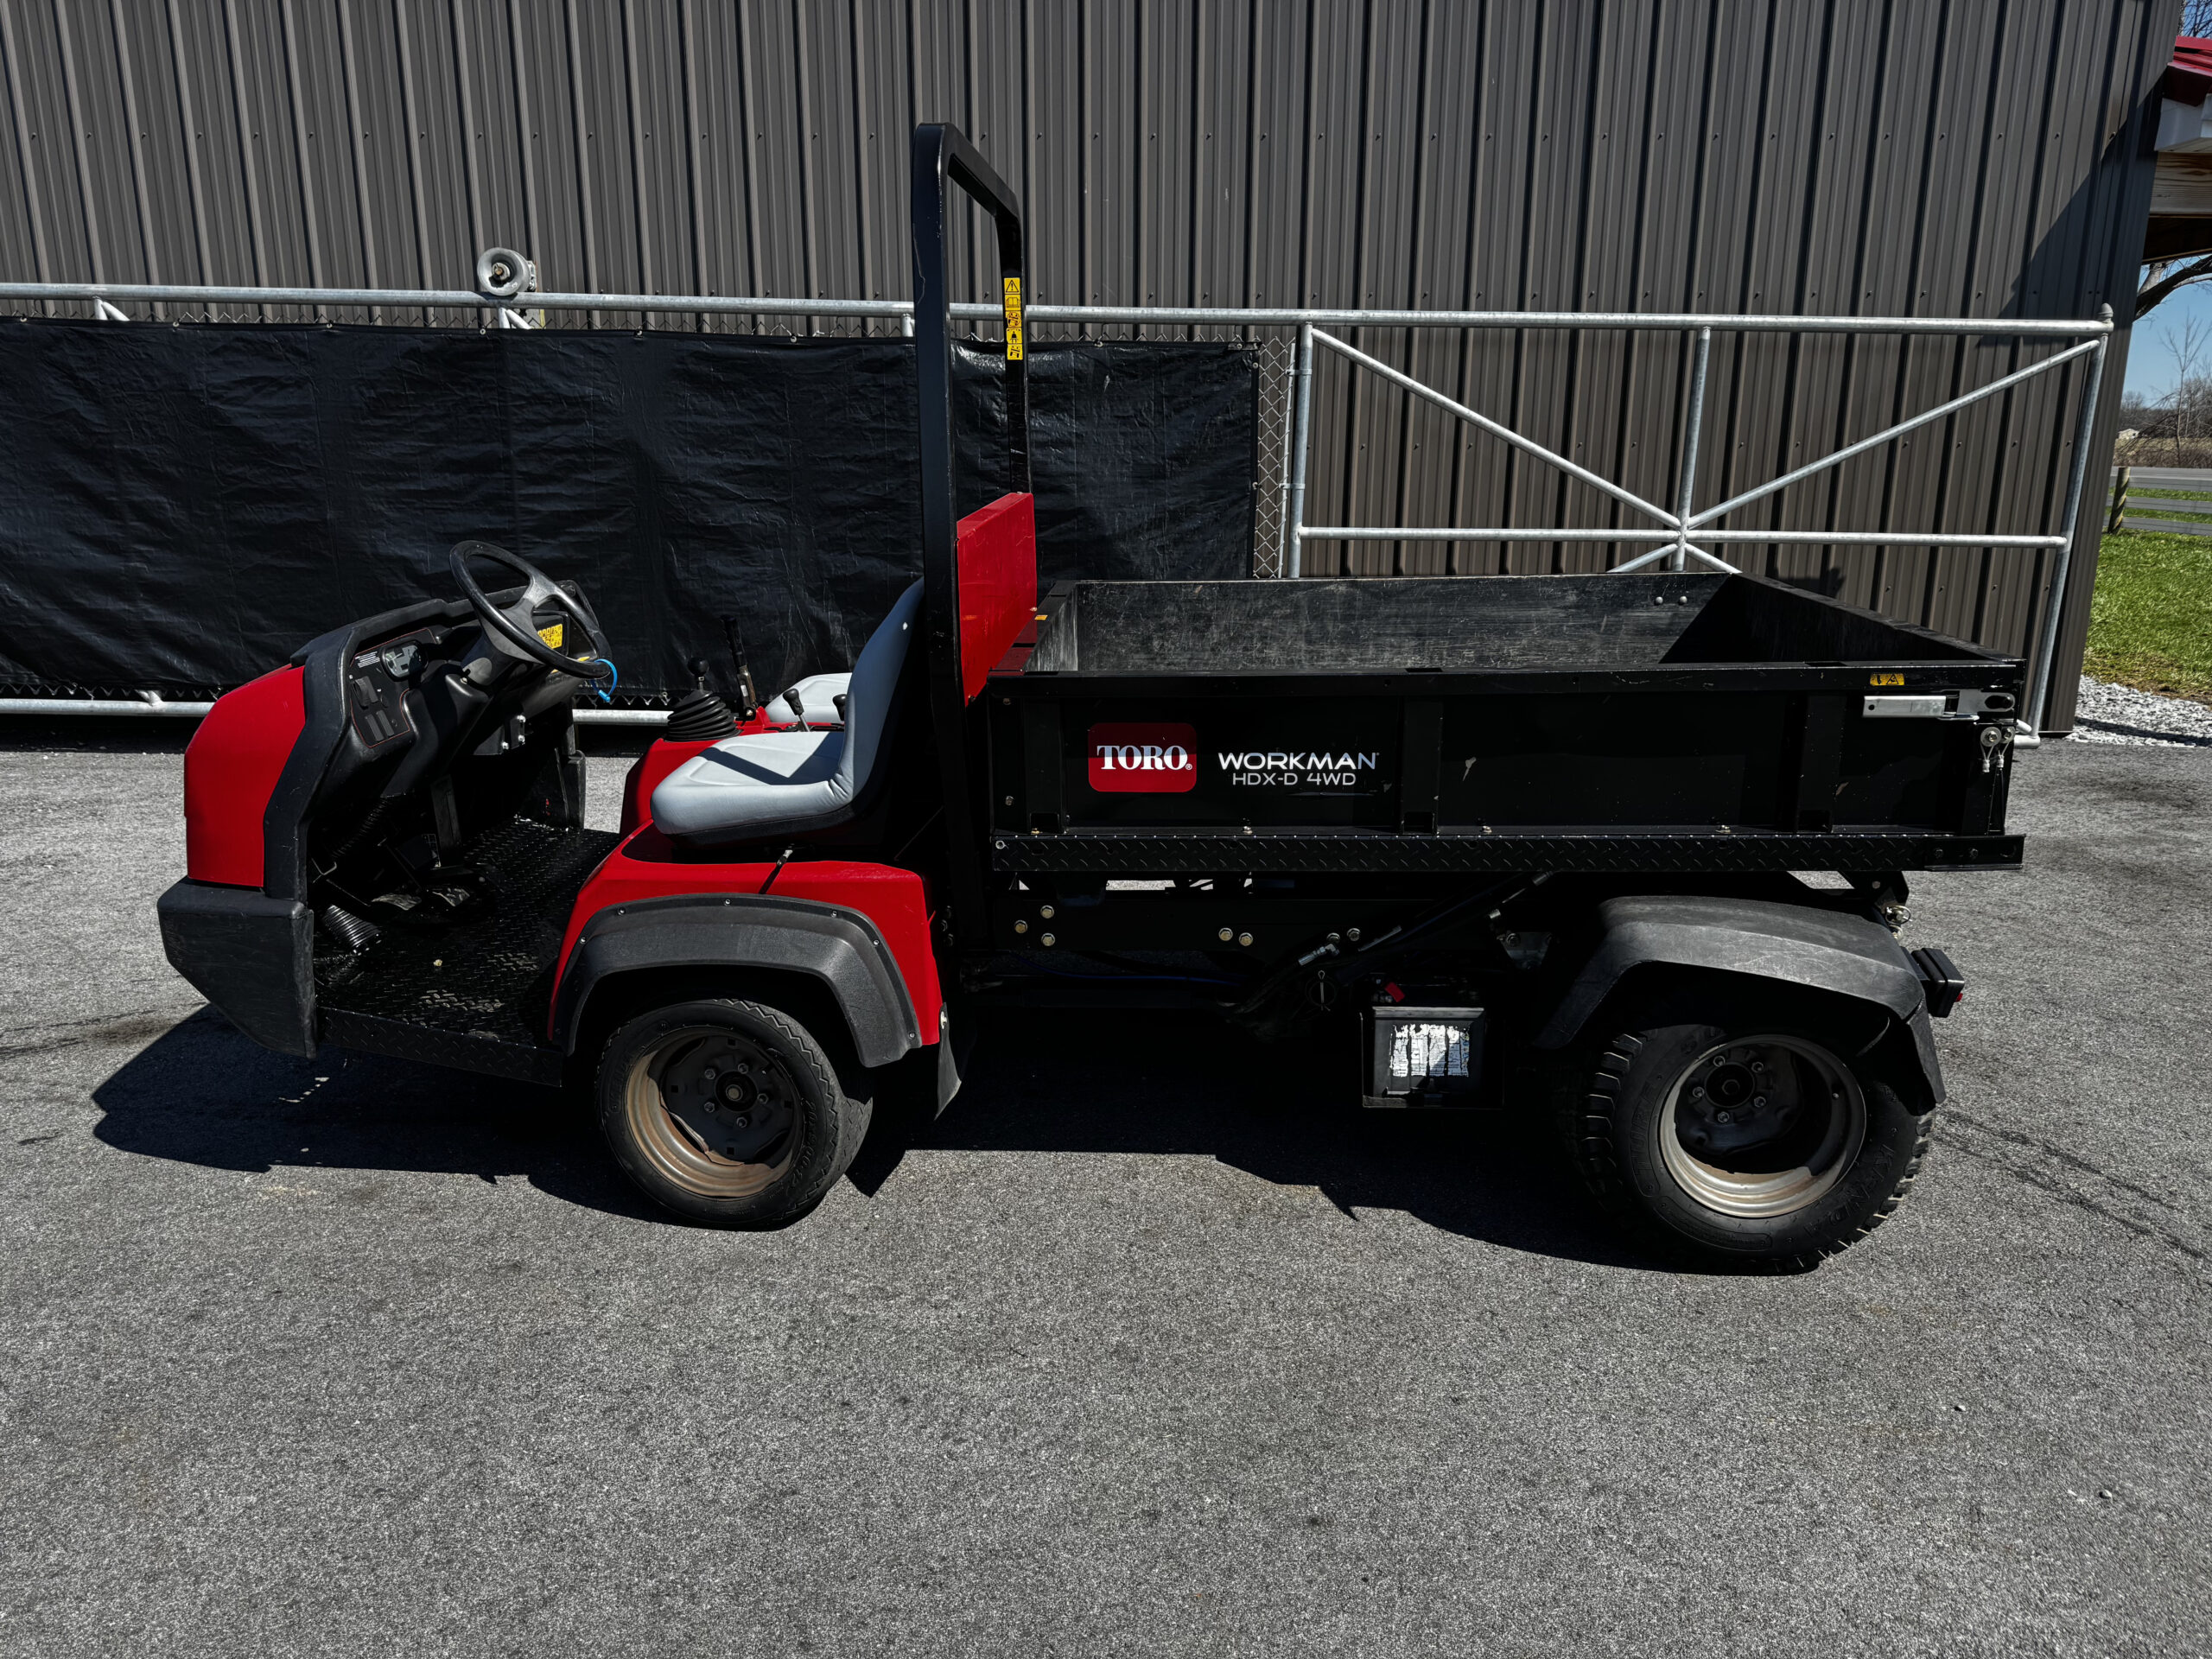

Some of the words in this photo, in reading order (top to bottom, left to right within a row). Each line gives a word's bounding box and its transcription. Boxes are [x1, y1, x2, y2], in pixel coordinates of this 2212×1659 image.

[1217, 752, 1376, 770] WORKMAN
[1232, 772, 1299, 785] HDX-D
[1306, 772, 1357, 785] 4WD
